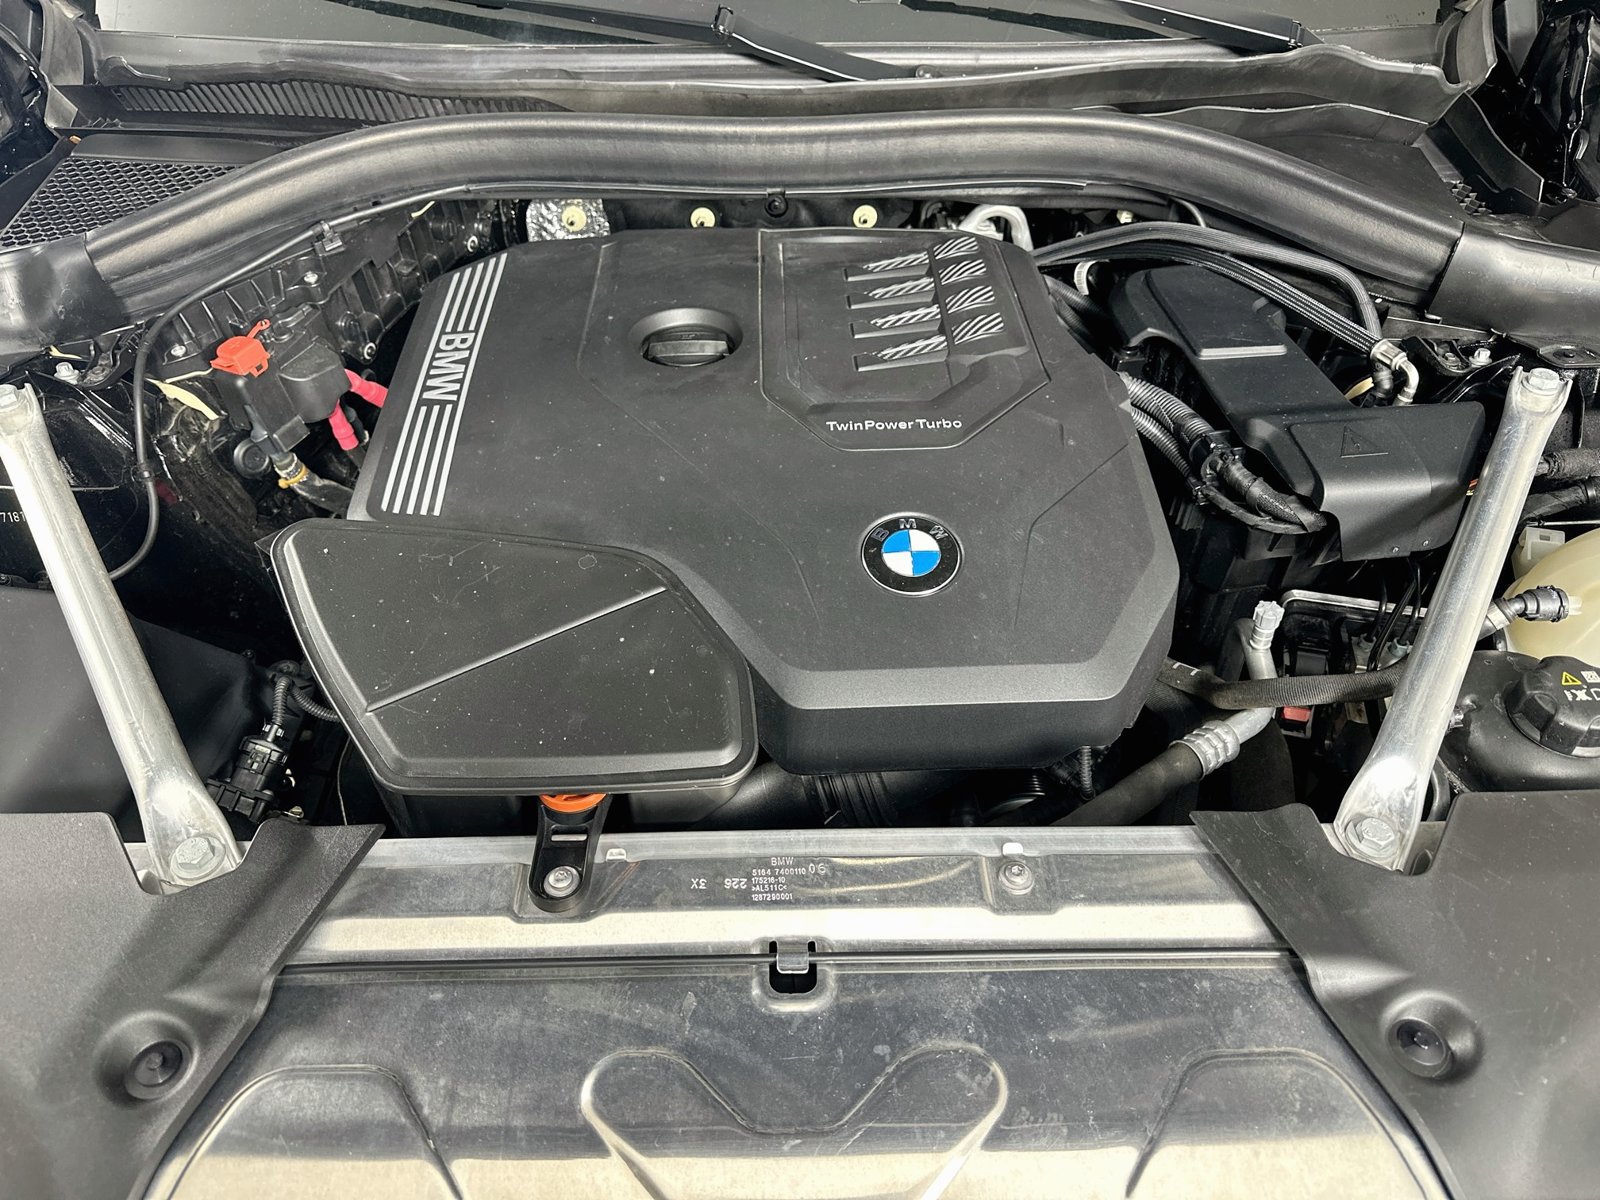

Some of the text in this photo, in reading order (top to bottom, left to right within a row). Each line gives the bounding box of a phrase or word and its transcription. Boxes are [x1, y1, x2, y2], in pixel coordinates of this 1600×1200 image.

[422, 332, 476, 402] BMW
[826, 418, 963, 431] TwinPower Turbo
[871, 518, 949, 542] BMW
[770, 857, 794, 866] BMW
[724, 878, 748, 889] 226
